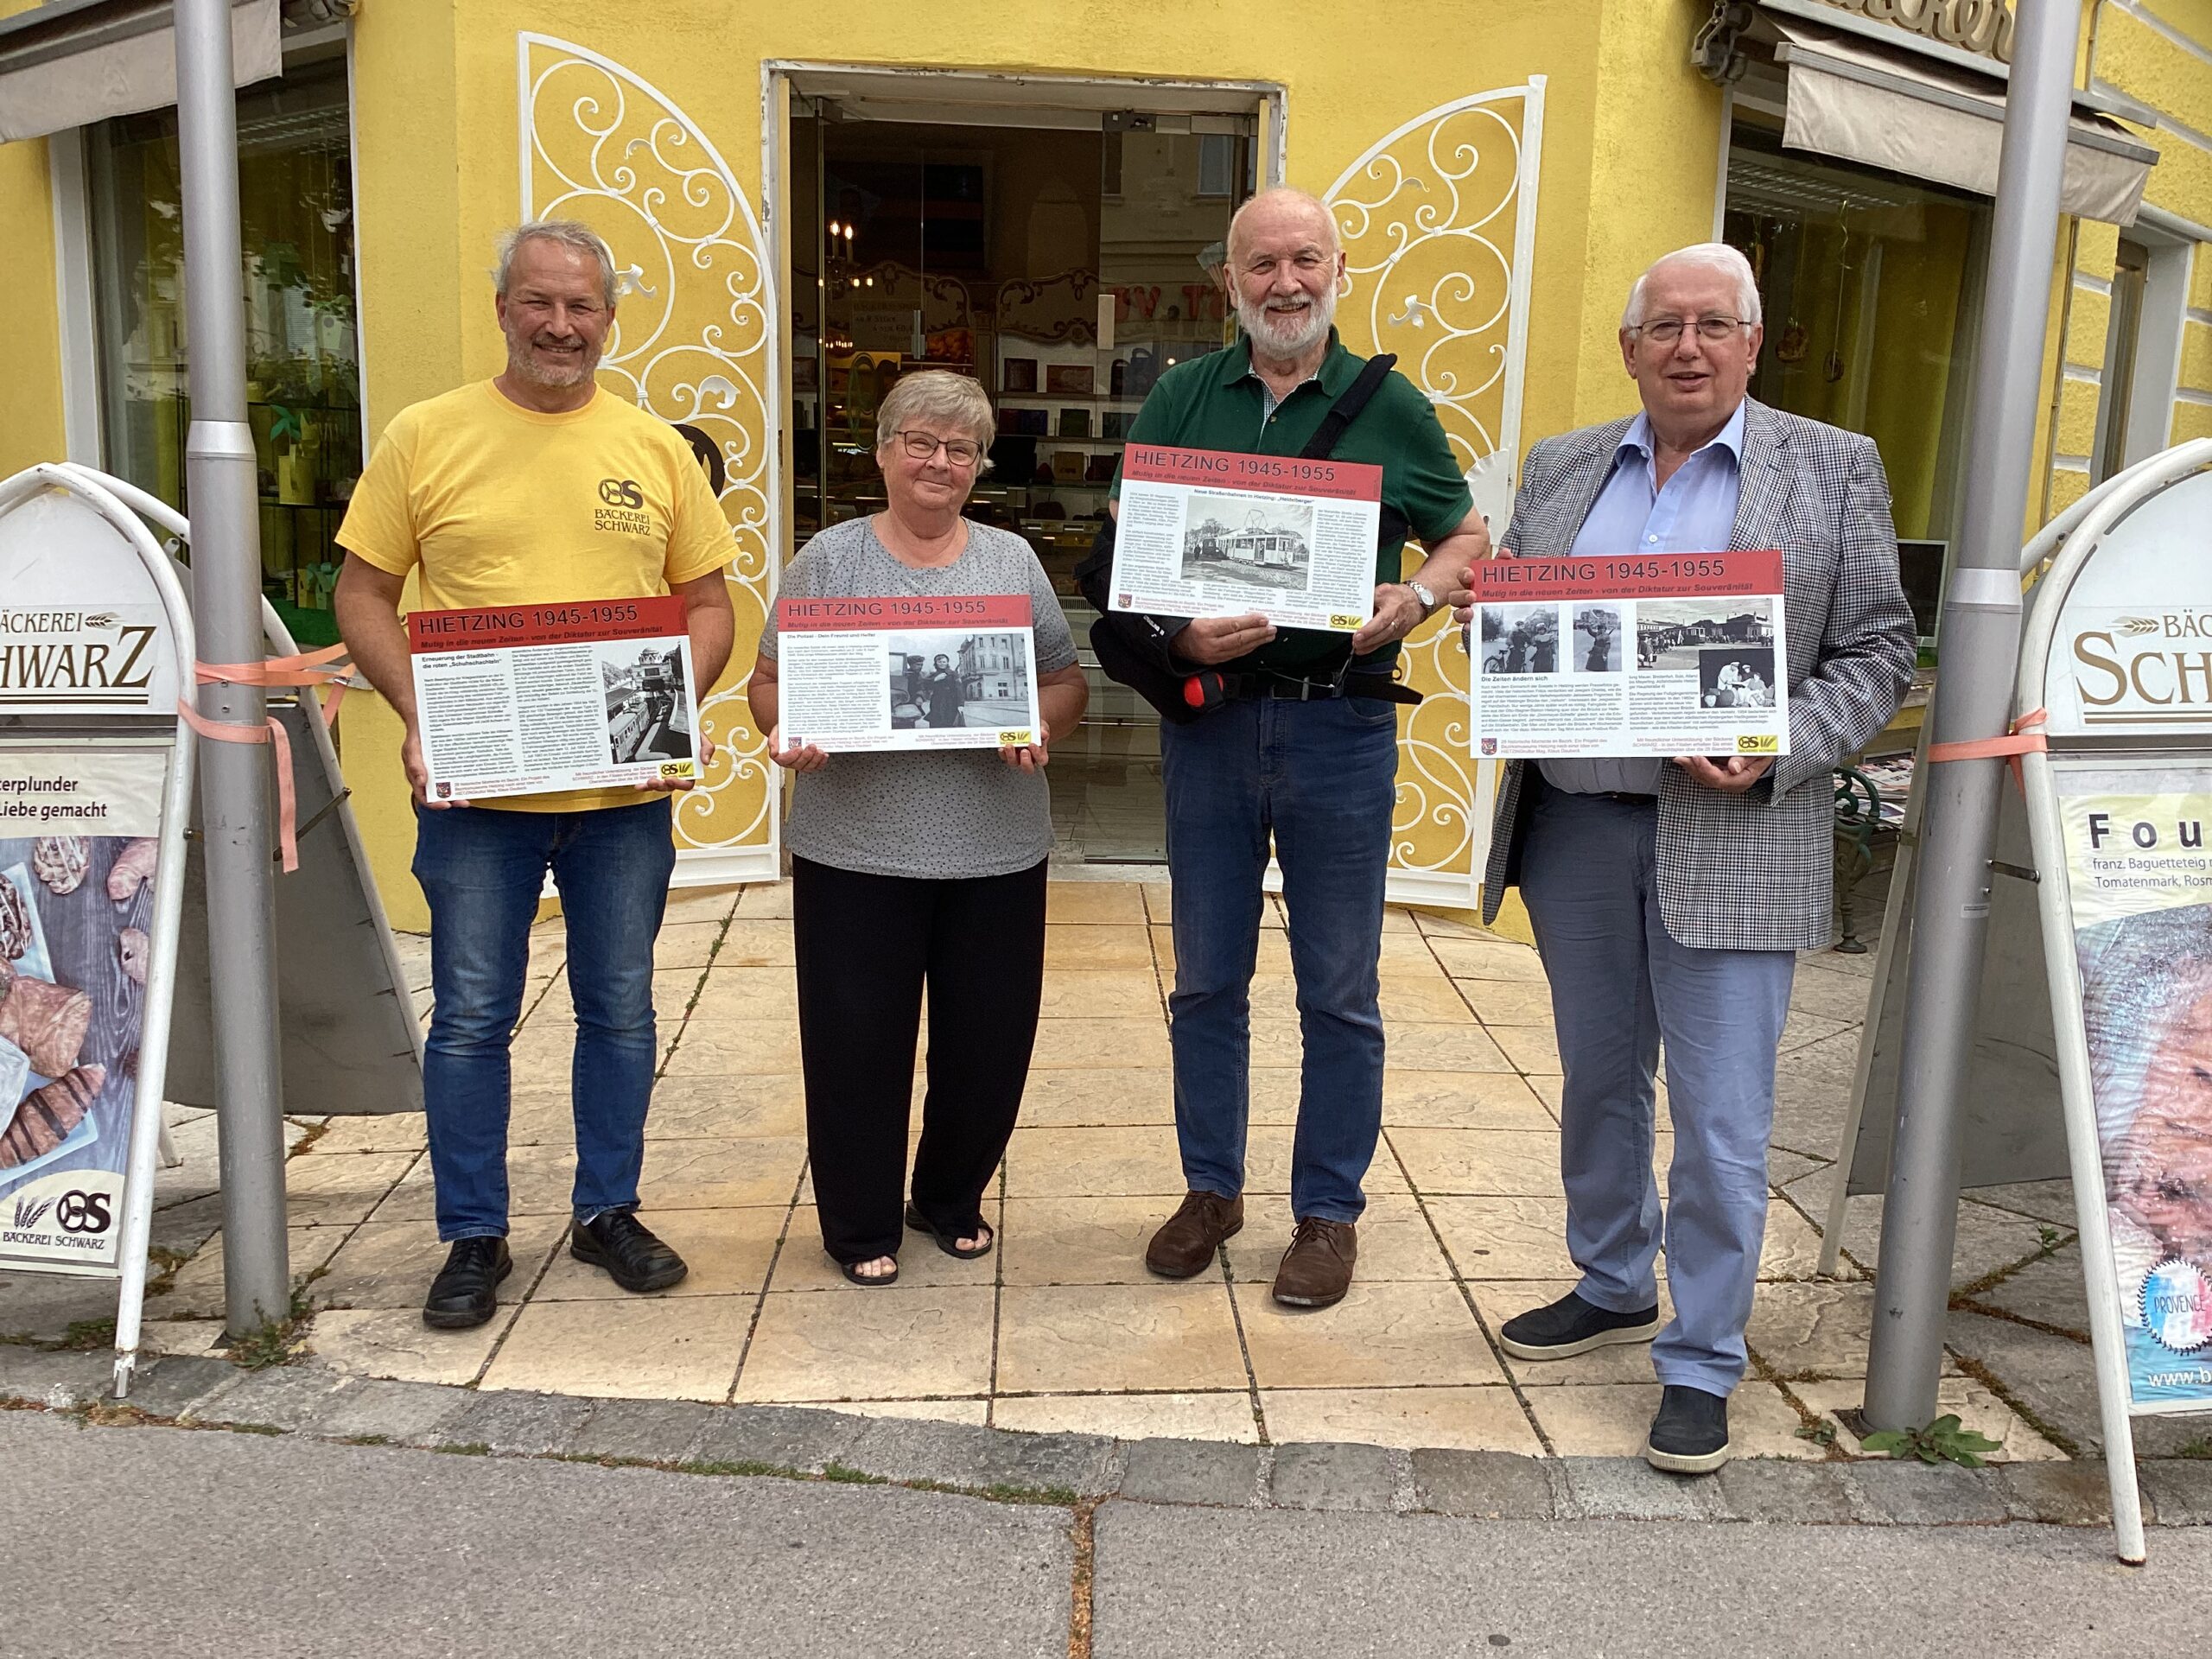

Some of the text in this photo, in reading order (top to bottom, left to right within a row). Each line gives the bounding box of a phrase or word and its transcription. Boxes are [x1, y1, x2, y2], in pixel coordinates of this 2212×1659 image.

[1135, 449, 1335, 480] HIETZING 1945-1955
[594, 520, 651, 537] SCHWARZ
[1484, 559, 1724, 582] HIETZING 1945-1955
[788, 601, 985, 617] HIETZING 1945-1955
[419, 605, 637, 633] HIETZING 1945-1955
[41, 802, 107, 821] gemacht
[2093, 856, 2206, 871] franz. Baguetteteig
[2094, 874, 2182, 888] Tomatenmark,
[54, 1236, 105, 1250] SCHWARZ
[2154, 1294, 2206, 1314] PROVENCE
